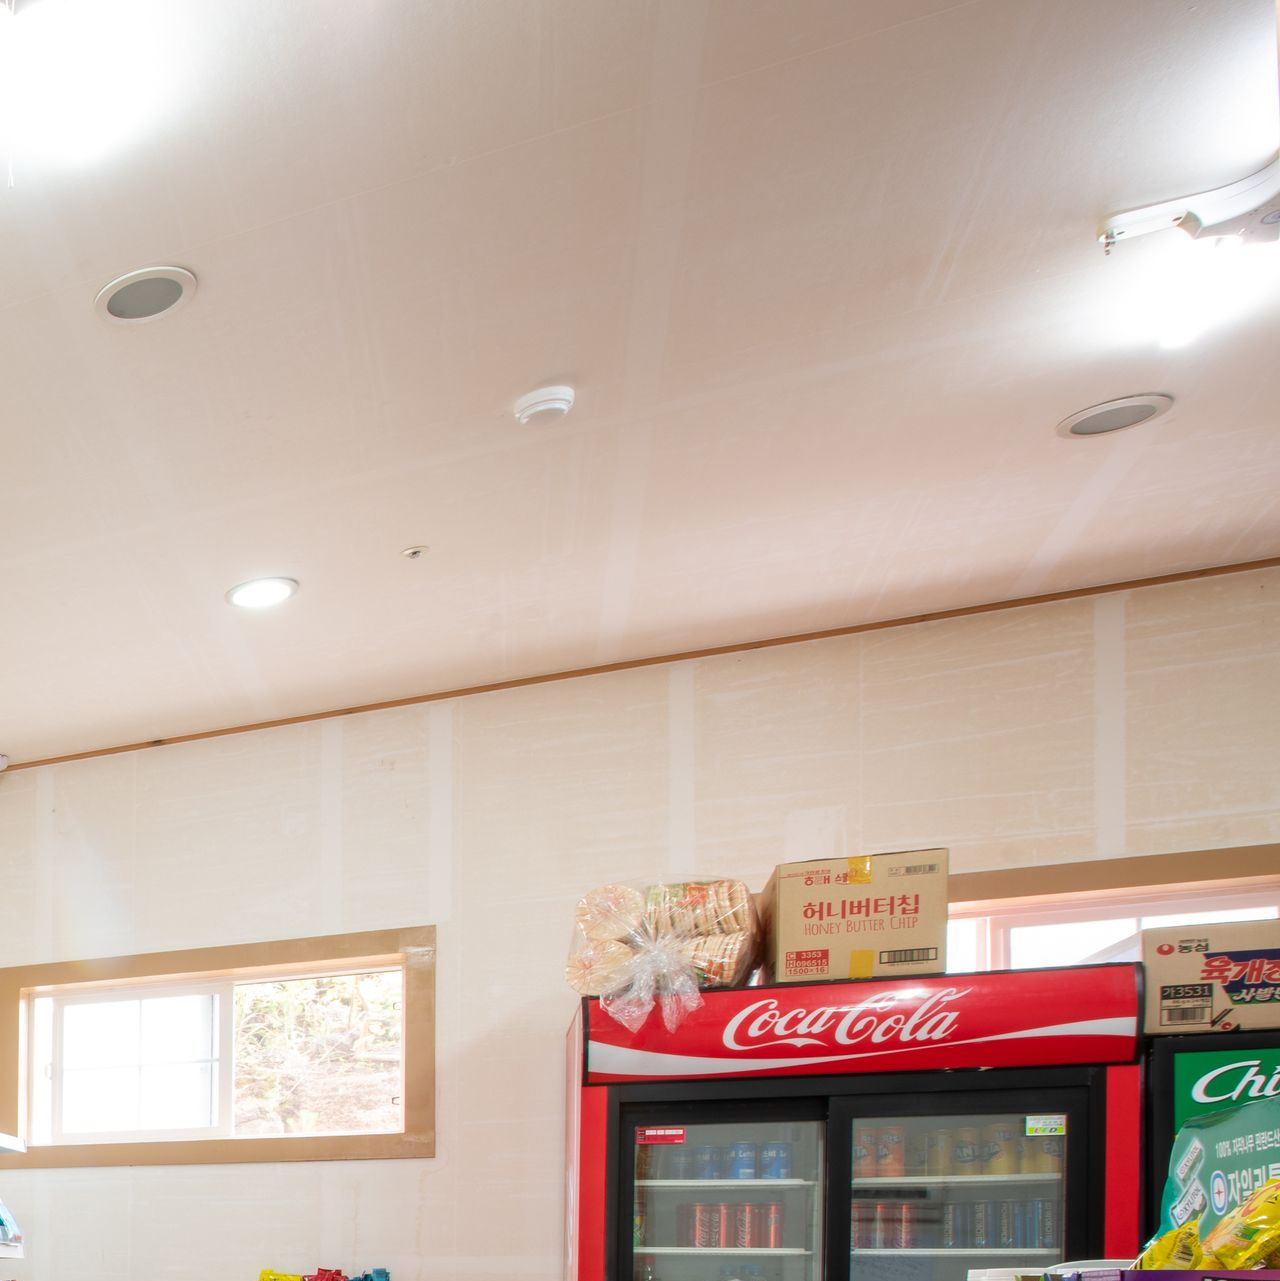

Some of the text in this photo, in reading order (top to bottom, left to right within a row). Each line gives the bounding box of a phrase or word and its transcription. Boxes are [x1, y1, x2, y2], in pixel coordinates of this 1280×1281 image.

[802, 893, 921, 922] 허니버터칩
[804, 915, 919, 936] HONEY BUTTER CHIP
[800, 950, 823, 959] 3353
[1177, 941, 1210, 954] 농심
